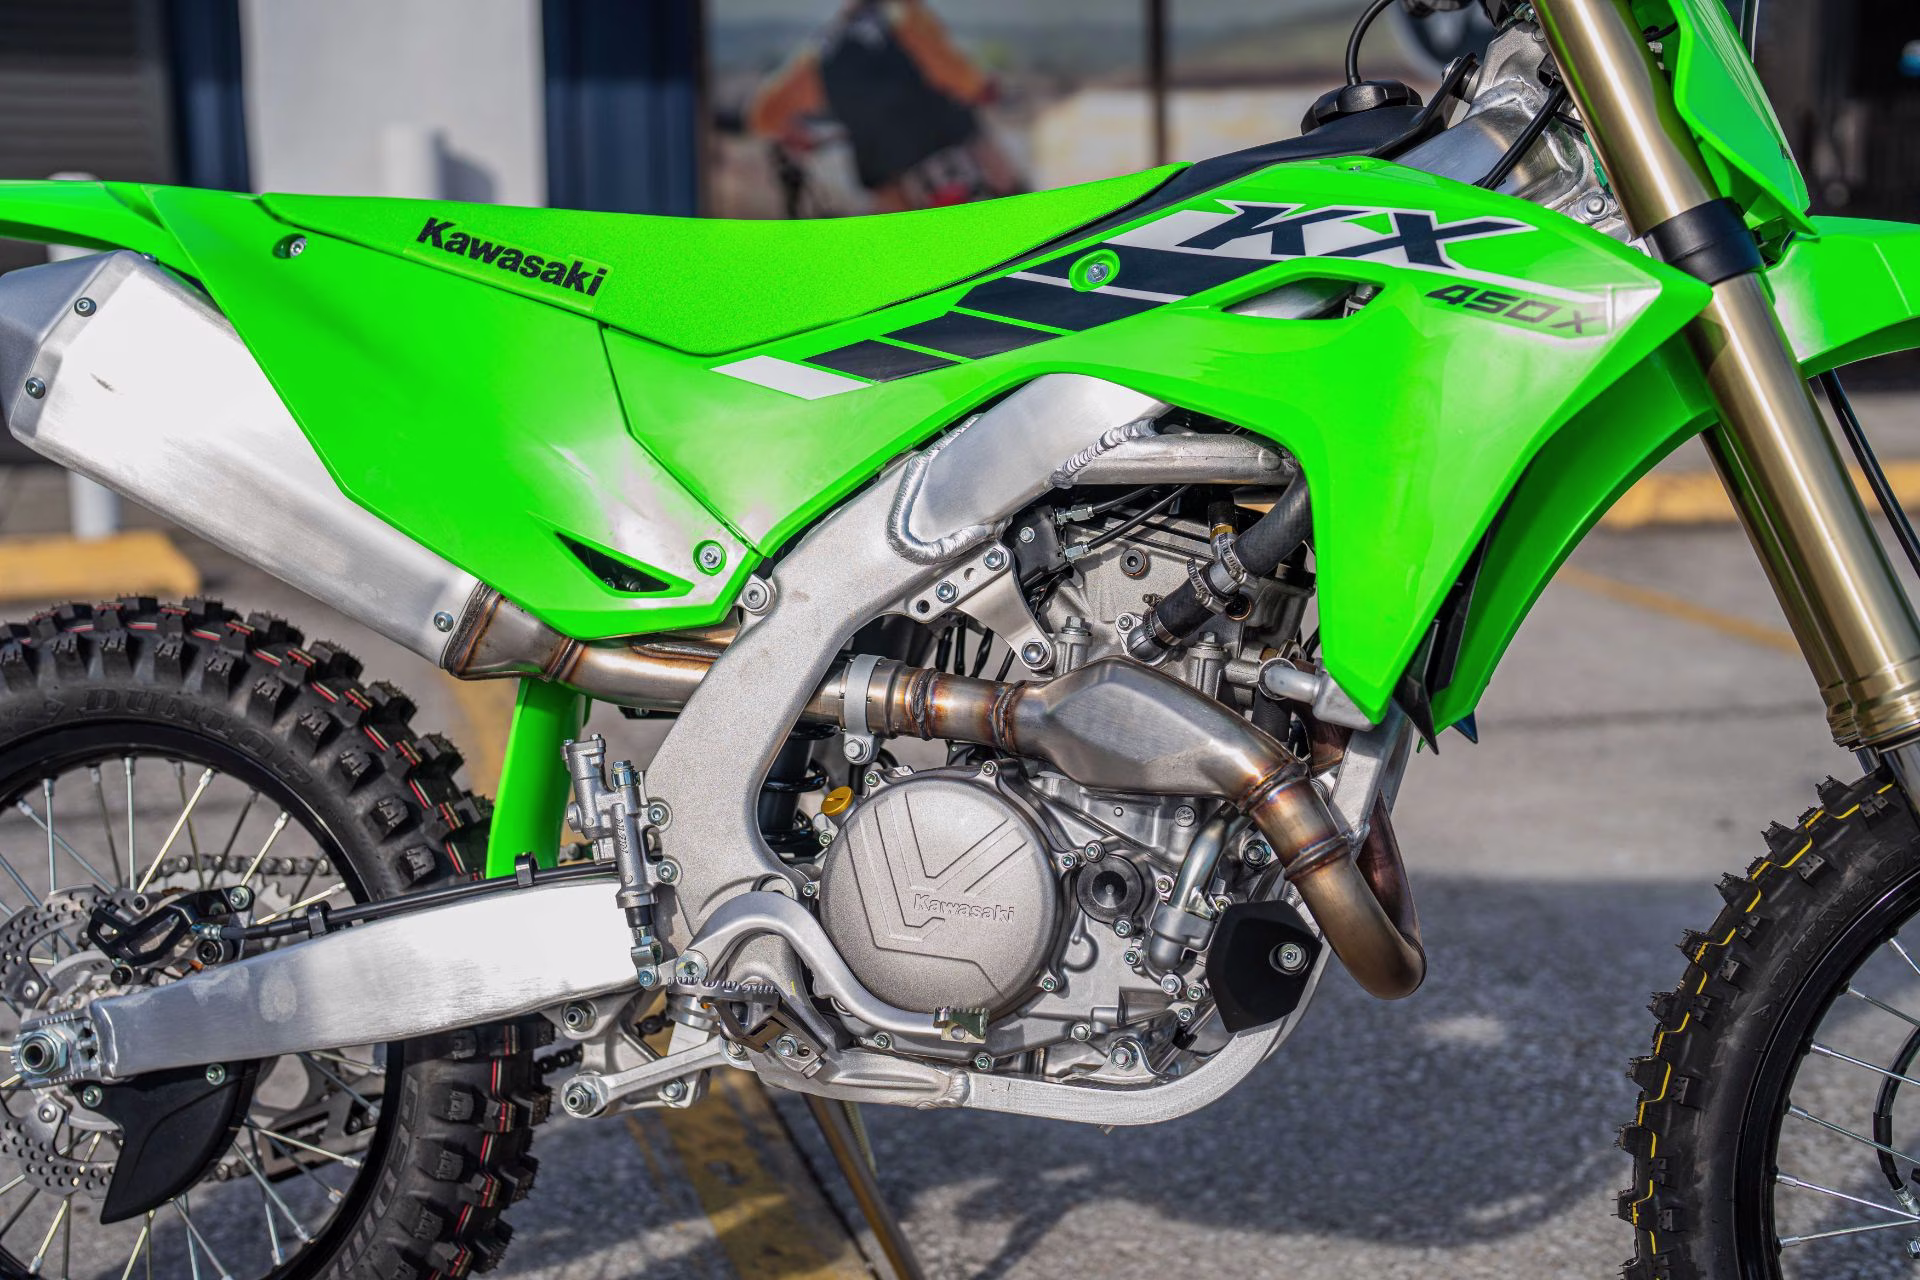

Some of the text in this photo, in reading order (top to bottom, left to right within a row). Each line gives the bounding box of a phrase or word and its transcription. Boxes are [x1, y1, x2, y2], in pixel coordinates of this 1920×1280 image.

[416, 217, 608, 297] Kawasaki
[1174, 204, 1527, 271] KX
[77, 687, 314, 786] DUNLOP
[913, 893, 1015, 922] Kawasaki
[329, 1072, 419, 1280] GEOM
